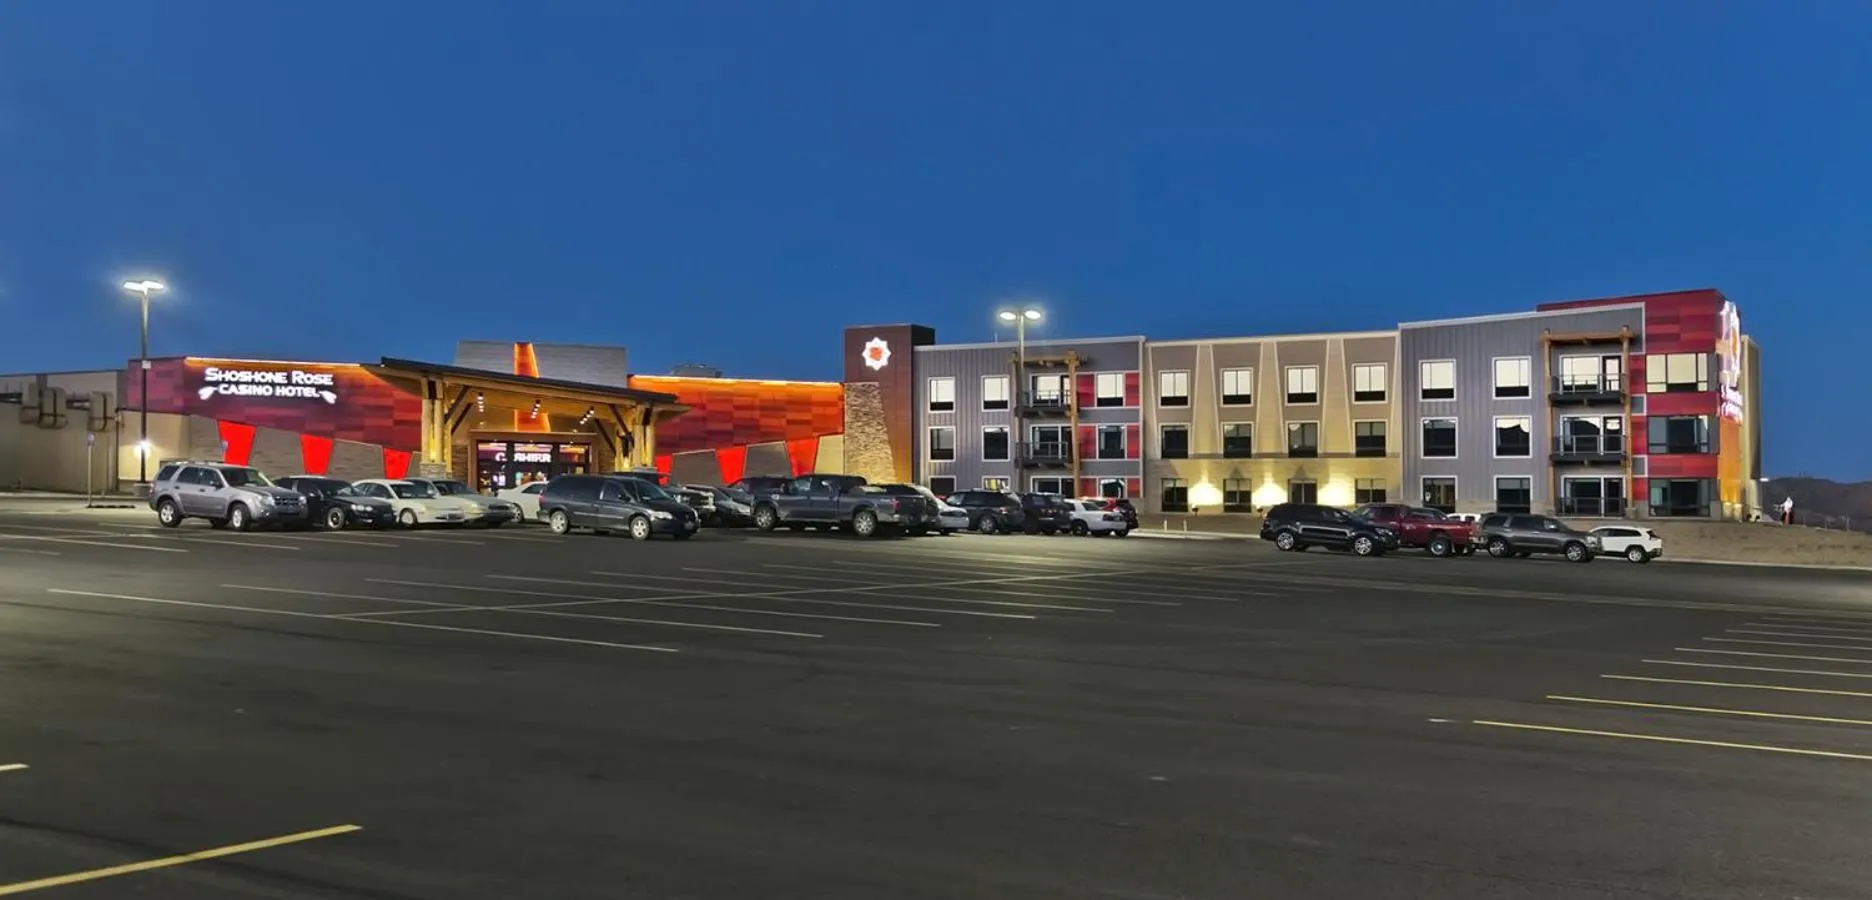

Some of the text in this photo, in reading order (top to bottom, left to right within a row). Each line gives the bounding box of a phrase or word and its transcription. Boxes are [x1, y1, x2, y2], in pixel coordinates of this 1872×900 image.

[205, 367, 333, 385] SHOSHONE ROSE
[219, 384, 320, 397] CASINO HOTEL
[495, 452, 551, 462] CSHIER
